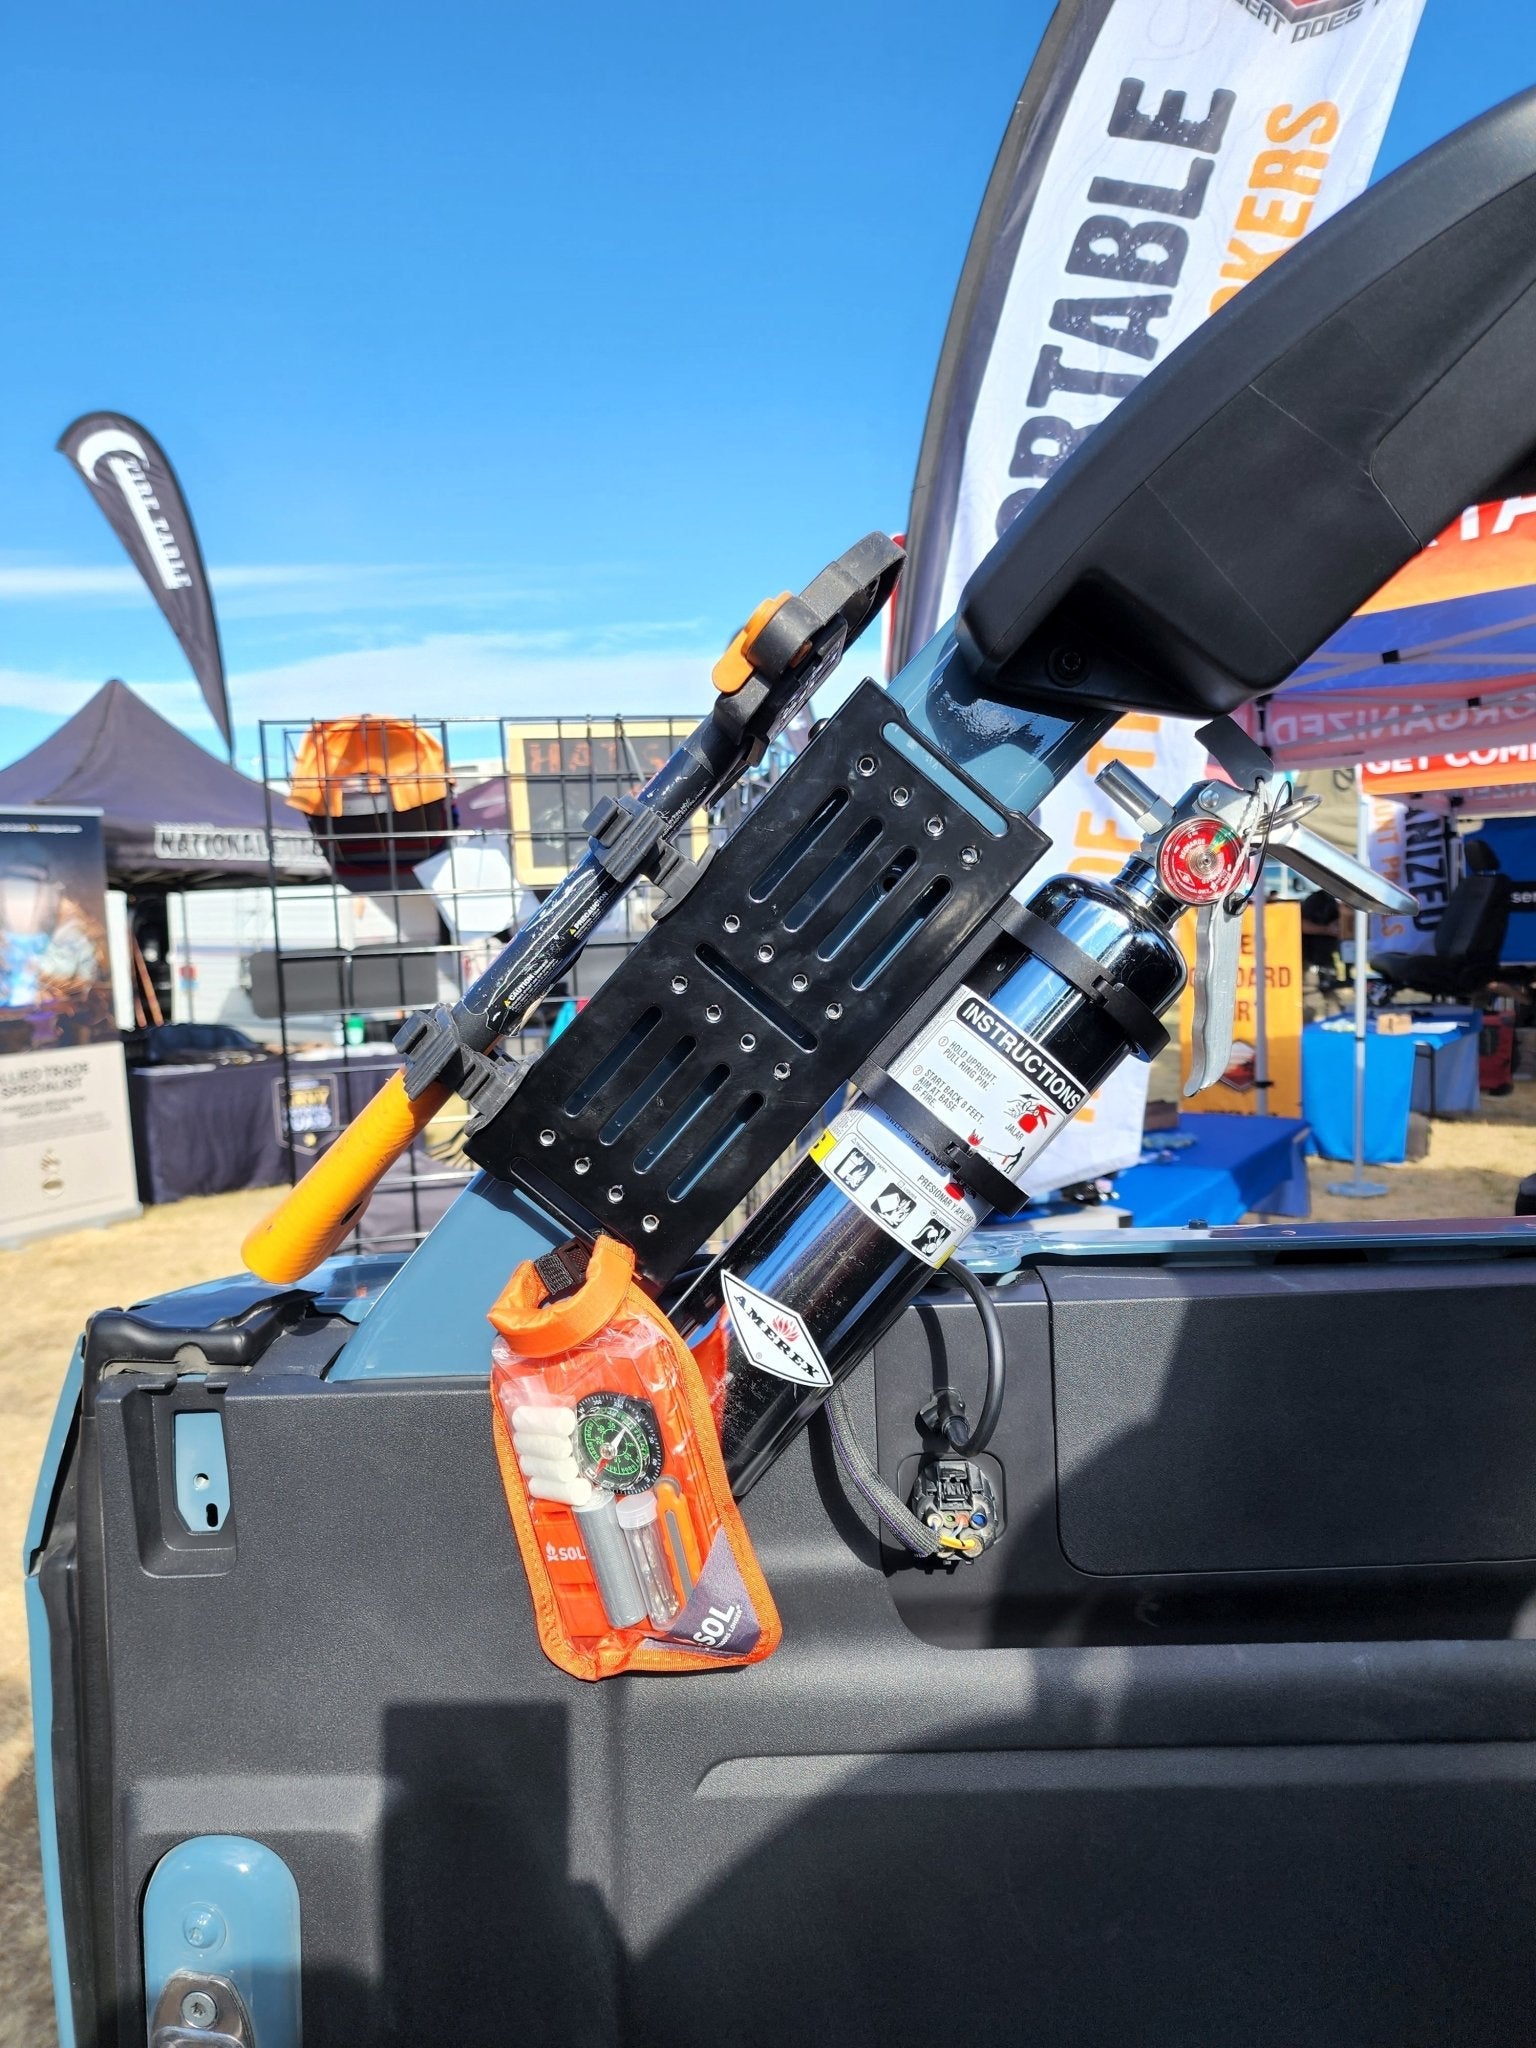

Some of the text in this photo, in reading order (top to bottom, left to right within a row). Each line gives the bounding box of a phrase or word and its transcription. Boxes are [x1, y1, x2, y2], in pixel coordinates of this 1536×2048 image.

[1291, 5, 1364, 44] DOES
[508, 973, 535, 1002] CAUTION
[941, 1047, 992, 1093] PULL RING PIN.
[948, 1040, 968, 1061] HOLD
[963, 1054, 1000, 1087] UPRIGHT.
[961, 1001, 1084, 1112] INSTRUCTIONS
[911, 1082, 939, 1109] OF FIRE.
[916, 1075, 958, 1114] AIM AT BASE
[922, 1068, 946, 1092] START
[941, 1084, 963, 1106] BACK
[964, 1105, 987, 1126] FEET.
[1003, 1121, 1026, 1143] JALAR
[916, 1174, 953, 1208] PRESIONAR
[949, 1202, 958, 1212] Y
[733, 1296, 820, 1379] AMEREX
[558, 1546, 587, 1562] SOL
[692, 1605, 734, 1644] SOL
